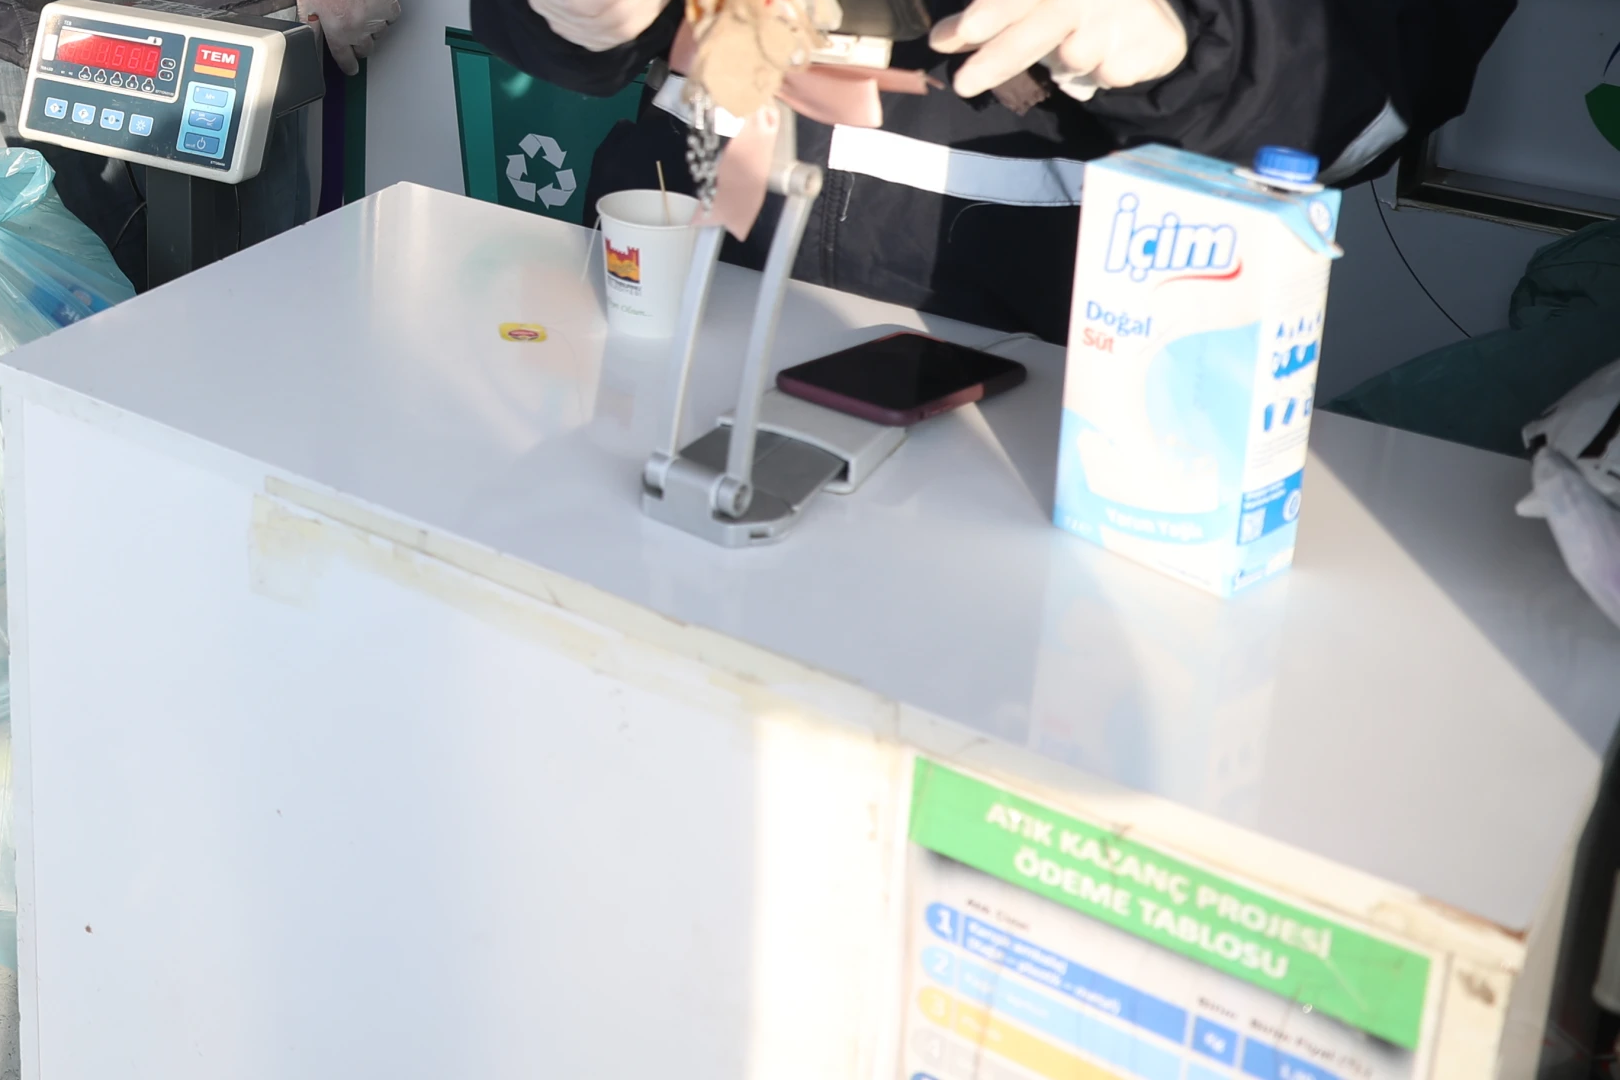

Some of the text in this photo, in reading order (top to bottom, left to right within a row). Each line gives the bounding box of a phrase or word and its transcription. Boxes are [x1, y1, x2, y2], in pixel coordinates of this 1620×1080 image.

[200, 49, 236, 65] TEM
[1104, 192, 1237, 283] İçim
[1086, 299, 1153, 338] Doğal
[1082, 325, 1115, 354] Süt
[986, 802, 1055, 847] ATIK
[1059, 828, 1192, 904] KAZANÇ
[937, 909, 953, 936] 1
[1013, 845, 1133, 917] ÖDEME
[1136, 897, 1290, 980] TABLOSU
[933, 951, 950, 975] 2
